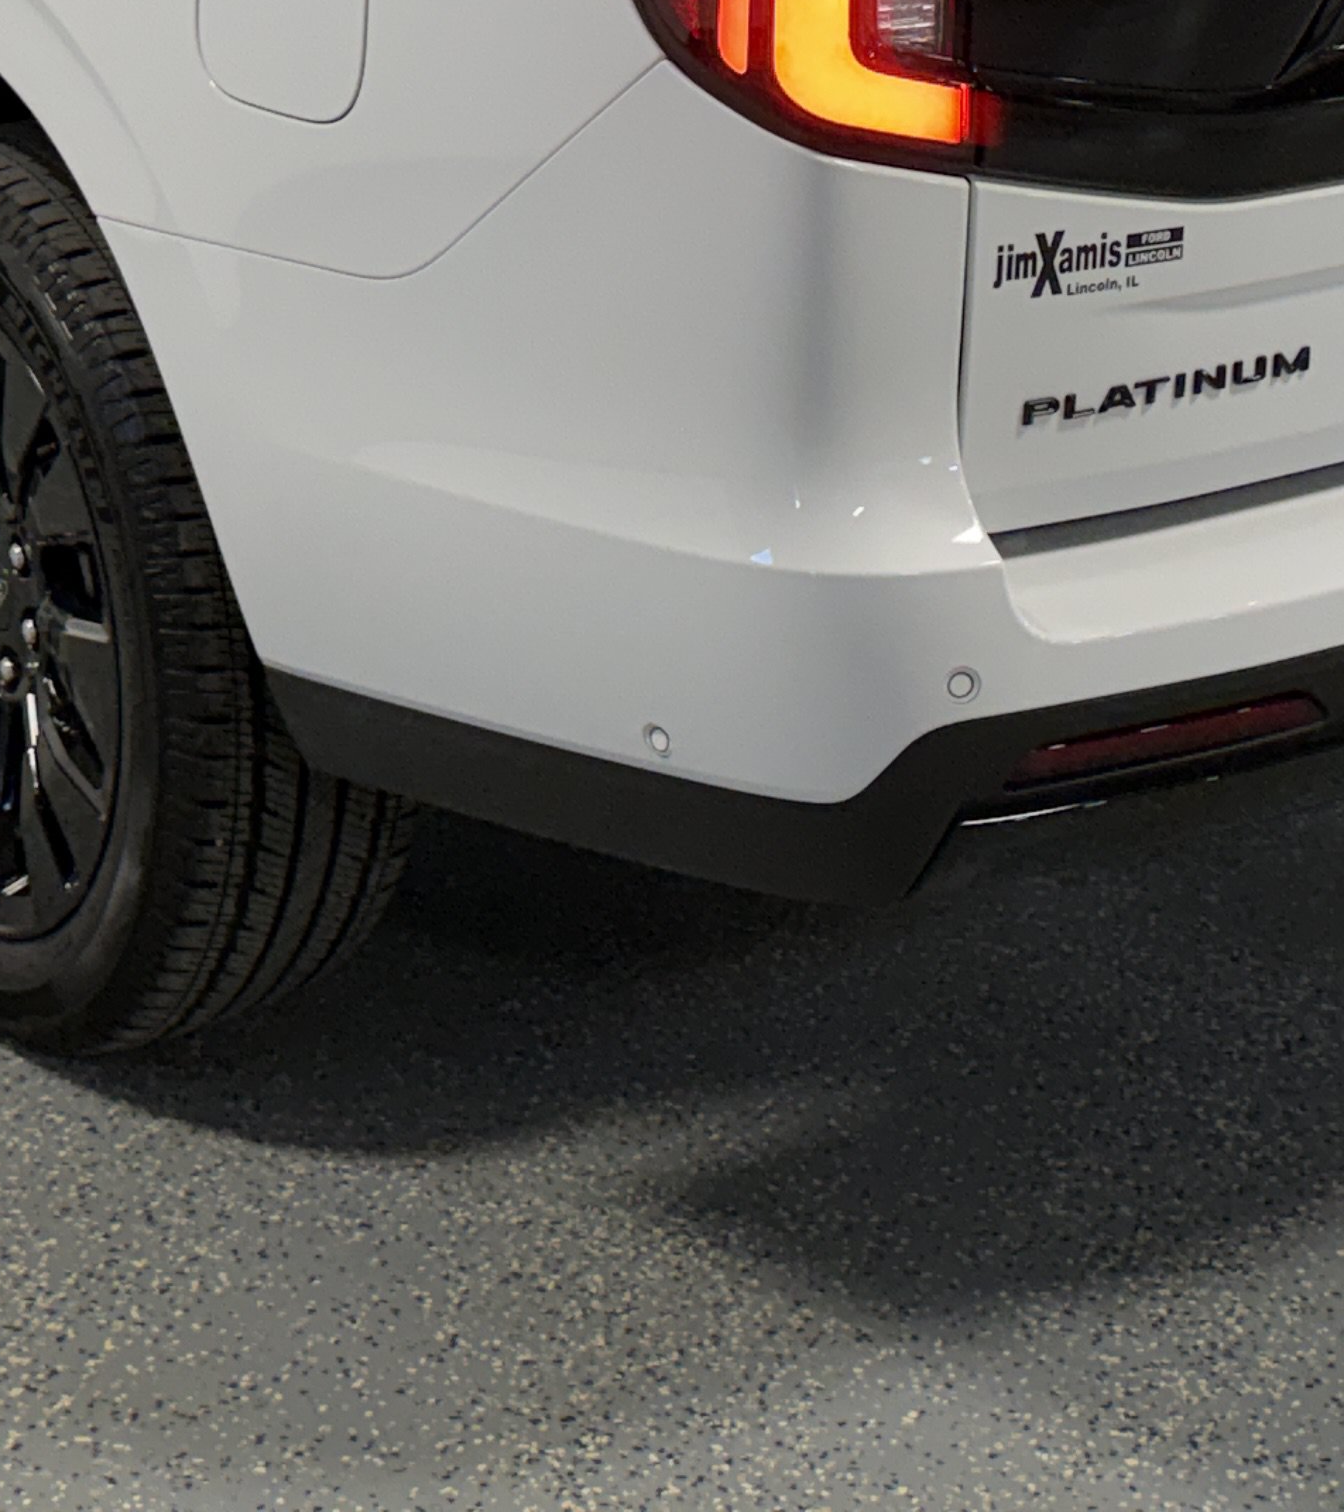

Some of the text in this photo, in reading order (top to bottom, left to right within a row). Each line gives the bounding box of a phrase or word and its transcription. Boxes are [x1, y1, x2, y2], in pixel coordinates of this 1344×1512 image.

[1127, 246, 1182, 266] LINCOLN
[1125, 275, 1140, 289] IL
[1021, 345, 1311, 427] PLATINUM
